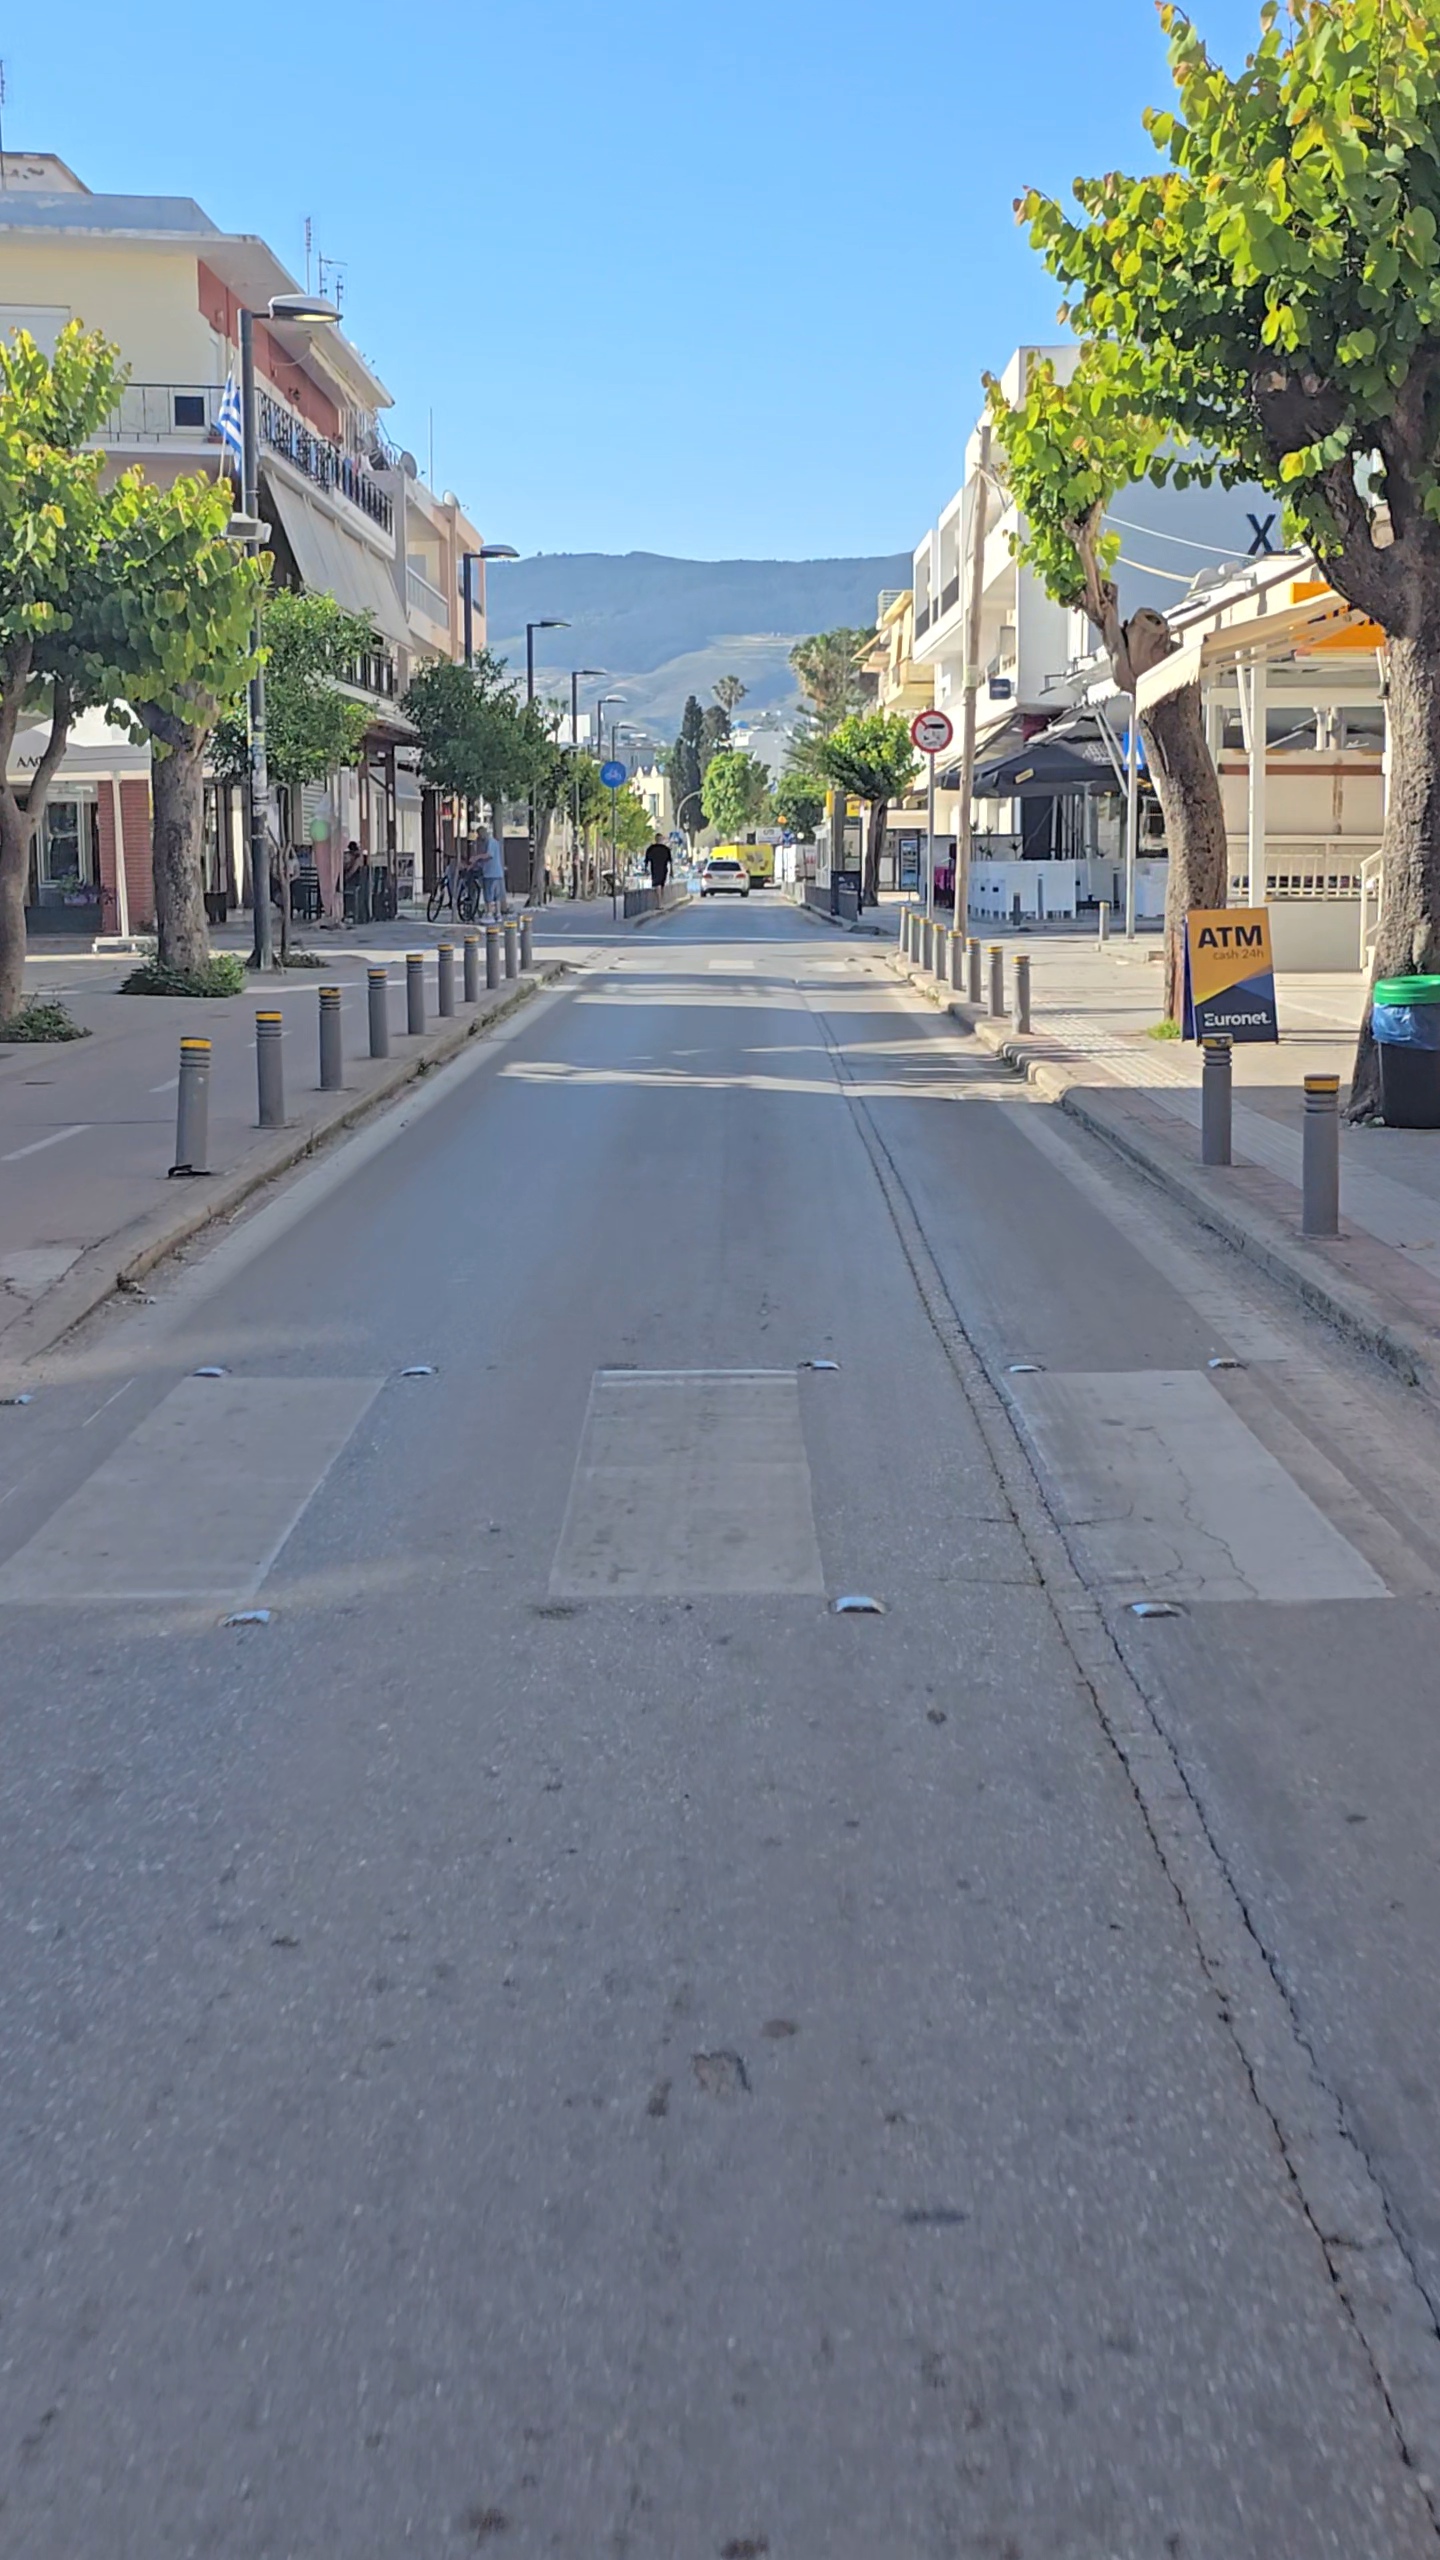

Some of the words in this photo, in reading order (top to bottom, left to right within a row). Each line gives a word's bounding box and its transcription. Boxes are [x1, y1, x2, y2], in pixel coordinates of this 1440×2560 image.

[1198, 925, 1263, 949] ATM
[1213, 949, 1238, 960] cash
[1241, 947, 1265, 960] 24h
[1203, 1011, 1272, 1027] Euronet
